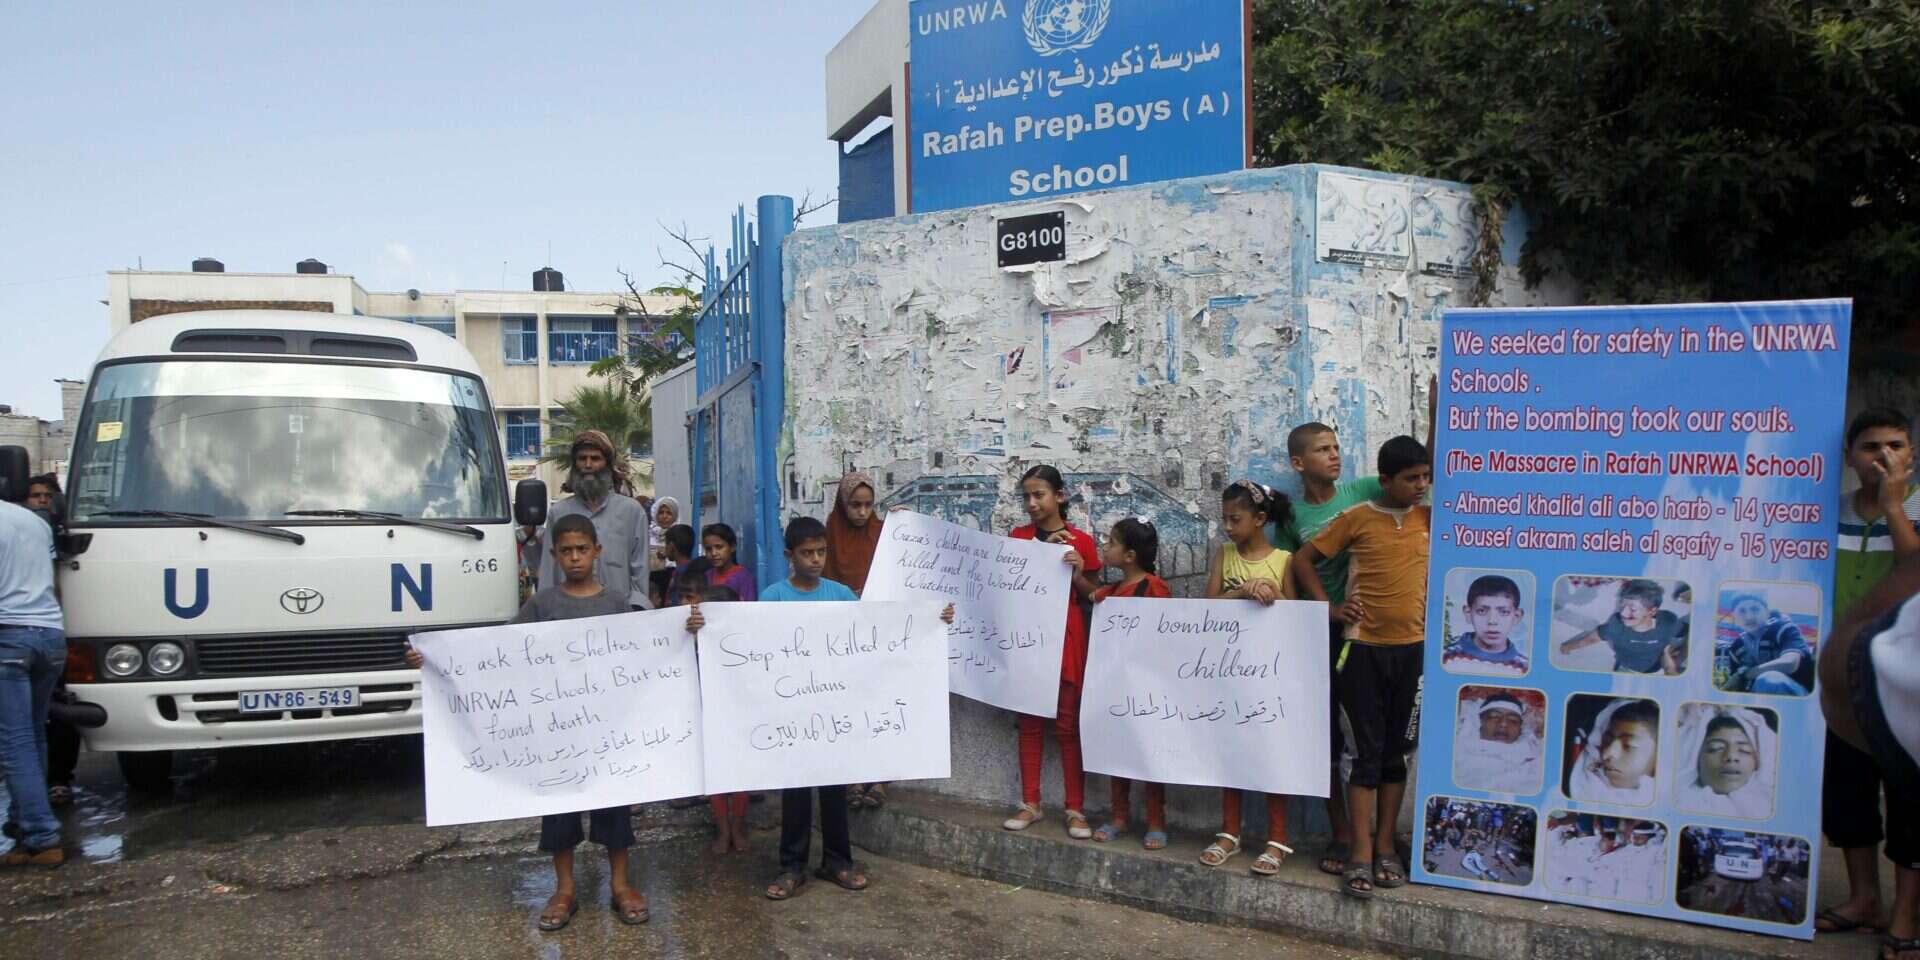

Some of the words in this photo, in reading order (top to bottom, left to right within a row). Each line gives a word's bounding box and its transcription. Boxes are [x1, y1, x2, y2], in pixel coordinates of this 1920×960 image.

[919, 0, 1007, 35] UNRWA
[1099, 45, 1144, 85] ذكور
[1150, 40, 1221, 75] مدرسة
[953, 67, 1043, 112] الإعدادية
[1048, 57, 1094, 97] رفح
[923, 122, 1004, 157] Rafah
[1008, 155, 1128, 196] School
[1000, 226, 1063, 251] G8100
[1452, 330, 1485, 356] We
[1489, 329, 1566, 355] seeked
[1571, 328, 1600, 354] for
[1606, 327, 1673, 359] safety
[1680, 327, 1700, 353] in
[1707, 326, 1745, 352] the
[1752, 323, 1838, 352] UNRWA
[1448, 406, 1481, 432] But
[1485, 406, 1519, 432] the
[1525, 406, 1625, 438] bombing
[1630, 406, 1681, 432] took
[1687, 412, 1725, 432] our
[1730, 406, 1795, 433] souls.
[1446, 449, 1483, 477] (The
[1488, 451, 1577, 475] Massacre
[1583, 452, 1599, 475] in
[1605, 451, 1662, 476] Rafah
[1668, 452, 1739, 476] UNRWA
[1744, 452, 1824, 483] School)
[1455, 492, 1521, 515] Ahmed
[1527, 493, 1584, 517] khalid
[1589, 494, 1613, 518] ali
[1618, 495, 1658, 519] abo
[1664, 495, 1712, 521] harb
[1732, 498, 1758, 522] 14
[1763, 504, 1821, 527] years
[973, 548, 989, 560] are
[996, 541, 1028, 574] being
[1454, 524, 1512, 549] Yousef
[1516, 526, 1576, 550] akram
[1582, 528, 1634, 553] saleh
[1640, 529, 1659, 554] al
[1663, 531, 1721, 560] sqafy
[1740, 533, 1765, 557] 15
[1771, 538, 1829, 563] years
[462, 558, 498, 574] 566
[940, 556, 964, 576] and
[967, 559, 982, 583] the
[1034, 584, 1048, 596] is
[1157, 609, 1248, 644] bombing
[438, 656, 466, 677] We
[478, 647, 512, 671] ask
[524, 634, 555, 666] for
[653, 636, 670, 648] in
[720, 633, 774, 671] Stop
[781, 626, 811, 658] the
[449, 689, 519, 715] UNRWA
[611, 665, 650, 688] But
[484, 712, 535, 740] found
[1188, 700, 1227, 722] قصف
[826, 714, 853, 744] قتل
